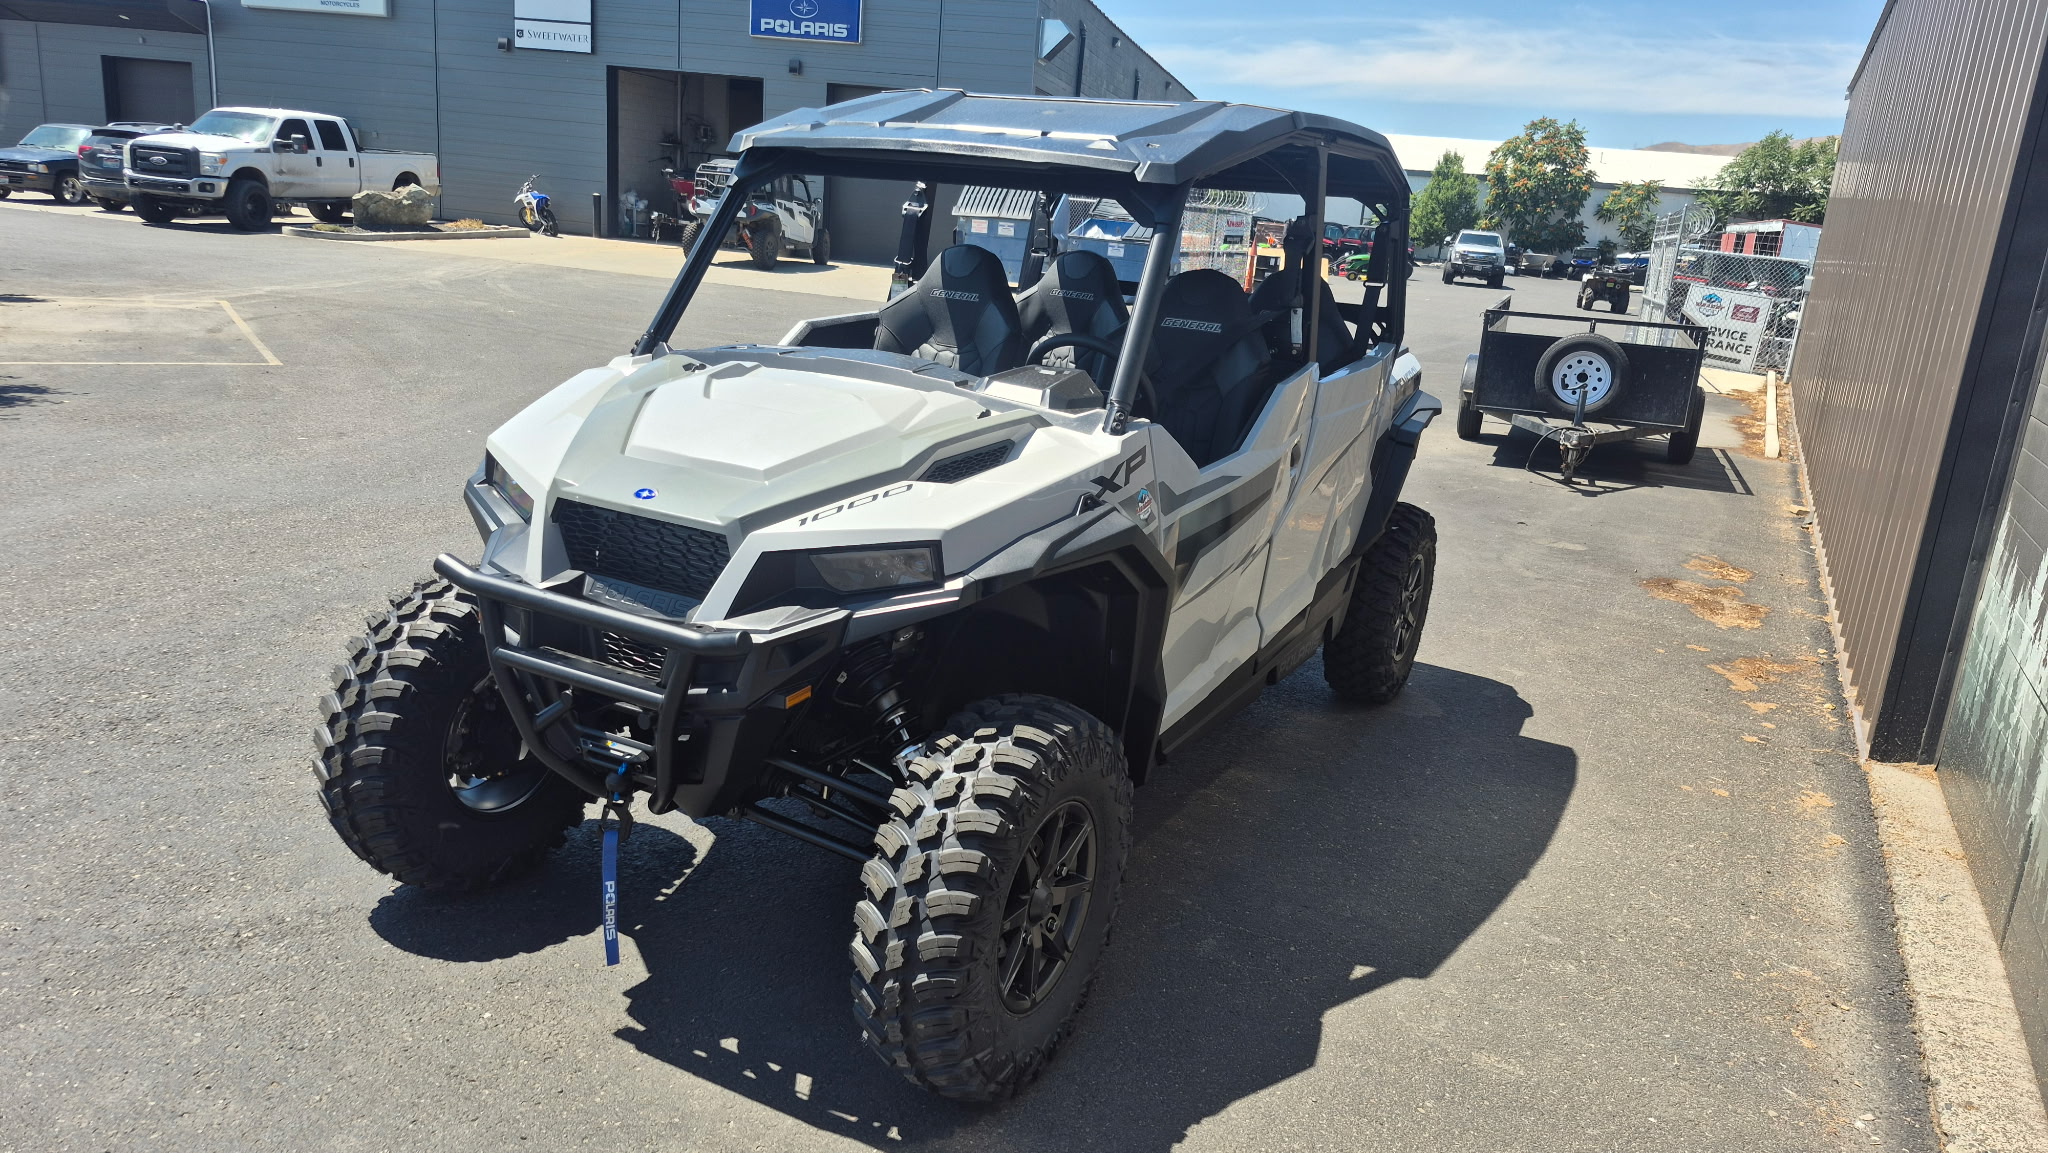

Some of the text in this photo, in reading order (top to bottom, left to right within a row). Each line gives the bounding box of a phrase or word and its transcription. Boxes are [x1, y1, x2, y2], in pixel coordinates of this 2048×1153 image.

[320, 0, 360, 8] MOTORCYCLES
[760, 18, 848, 37] POLARIS
[527, 30, 589, 43] SWEETWATER
[930, 289, 979, 301] GENERAL
[1050, 288, 1094, 301] GENERAL
[1161, 317, 1221, 333] GENERAL
[1707, 325, 1748, 342] RVICE
[1706, 338, 1753, 355] RANCE
[1089, 445, 1147, 500] XP
[799, 483, 913, 527] 1000
[588, 579, 690, 616] POLARIS
[605, 880, 616, 941] POLARIS
